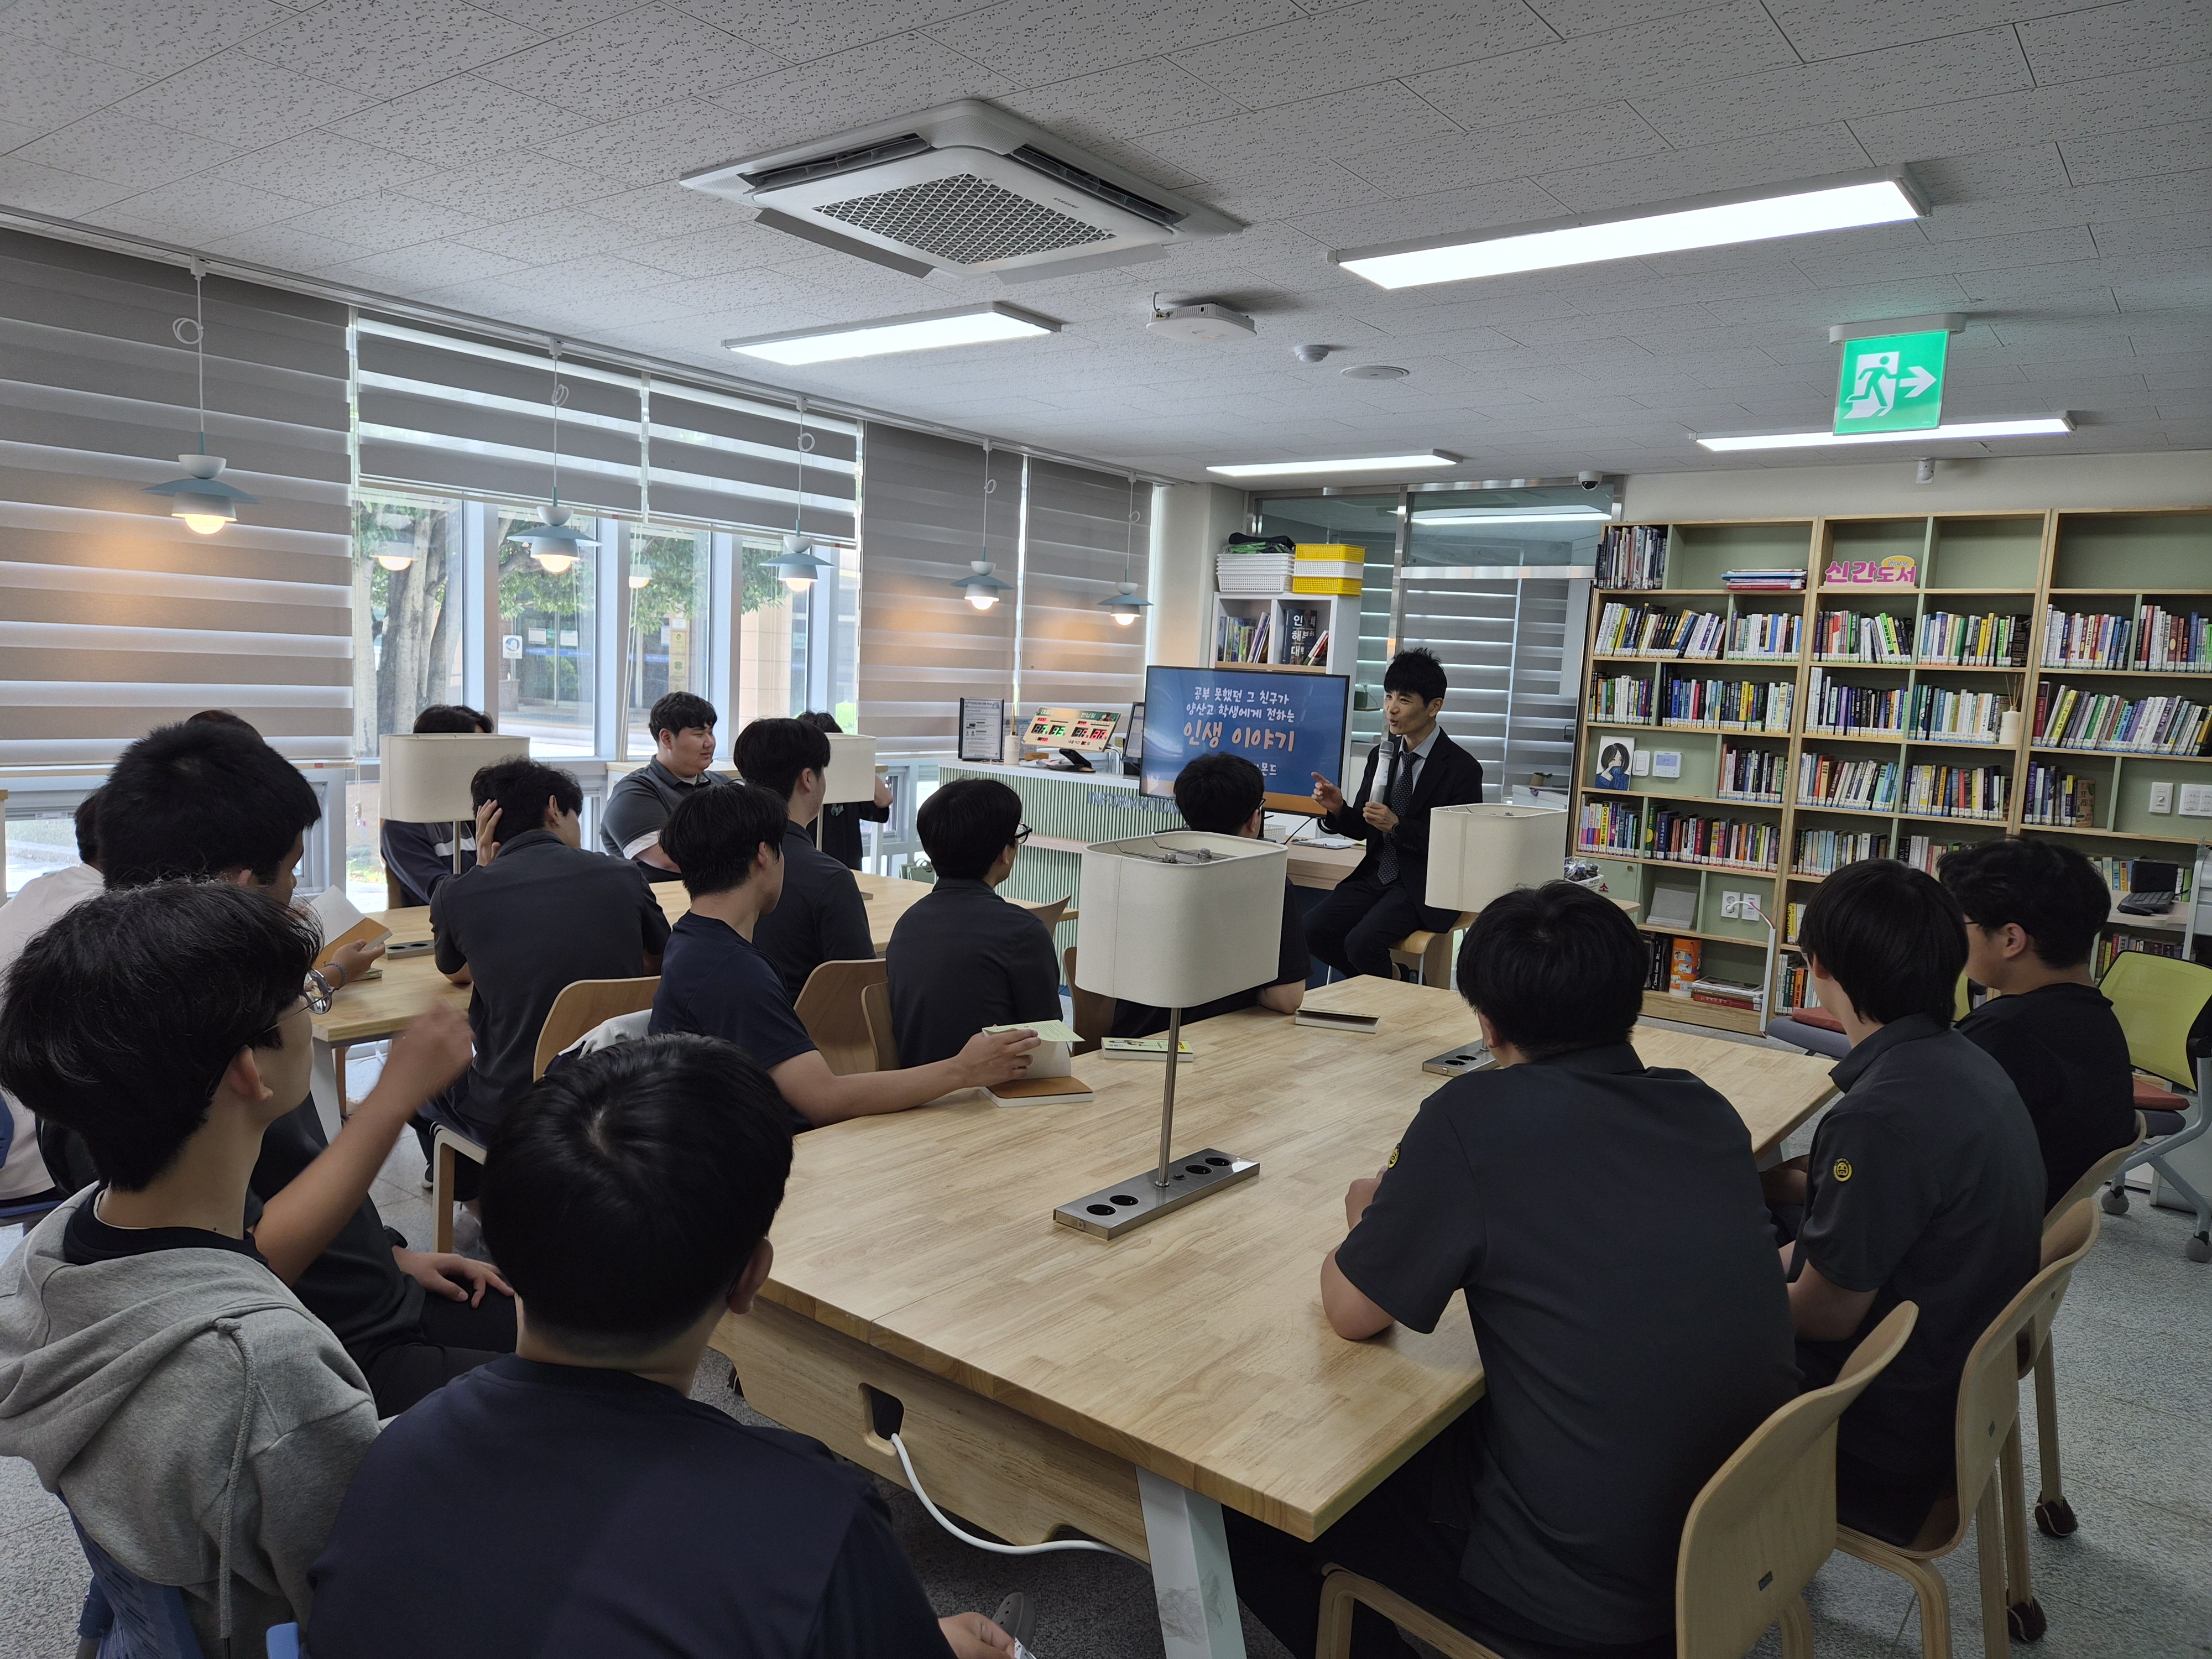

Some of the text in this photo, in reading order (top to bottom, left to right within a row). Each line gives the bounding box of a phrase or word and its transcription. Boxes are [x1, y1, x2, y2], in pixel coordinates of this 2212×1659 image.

[1053, 197, 1079, 209] SAMSUNG
[1825, 561, 1916, 583] 신간도서
[1194, 687, 1289, 705] 공부 못했던 그 친구가
[1186, 703, 1295, 723] 양산고 학생에게 전하는
[1183, 720, 1295, 752] 인생 이야기
[1088, 791, 1180, 815] INFORMATION
